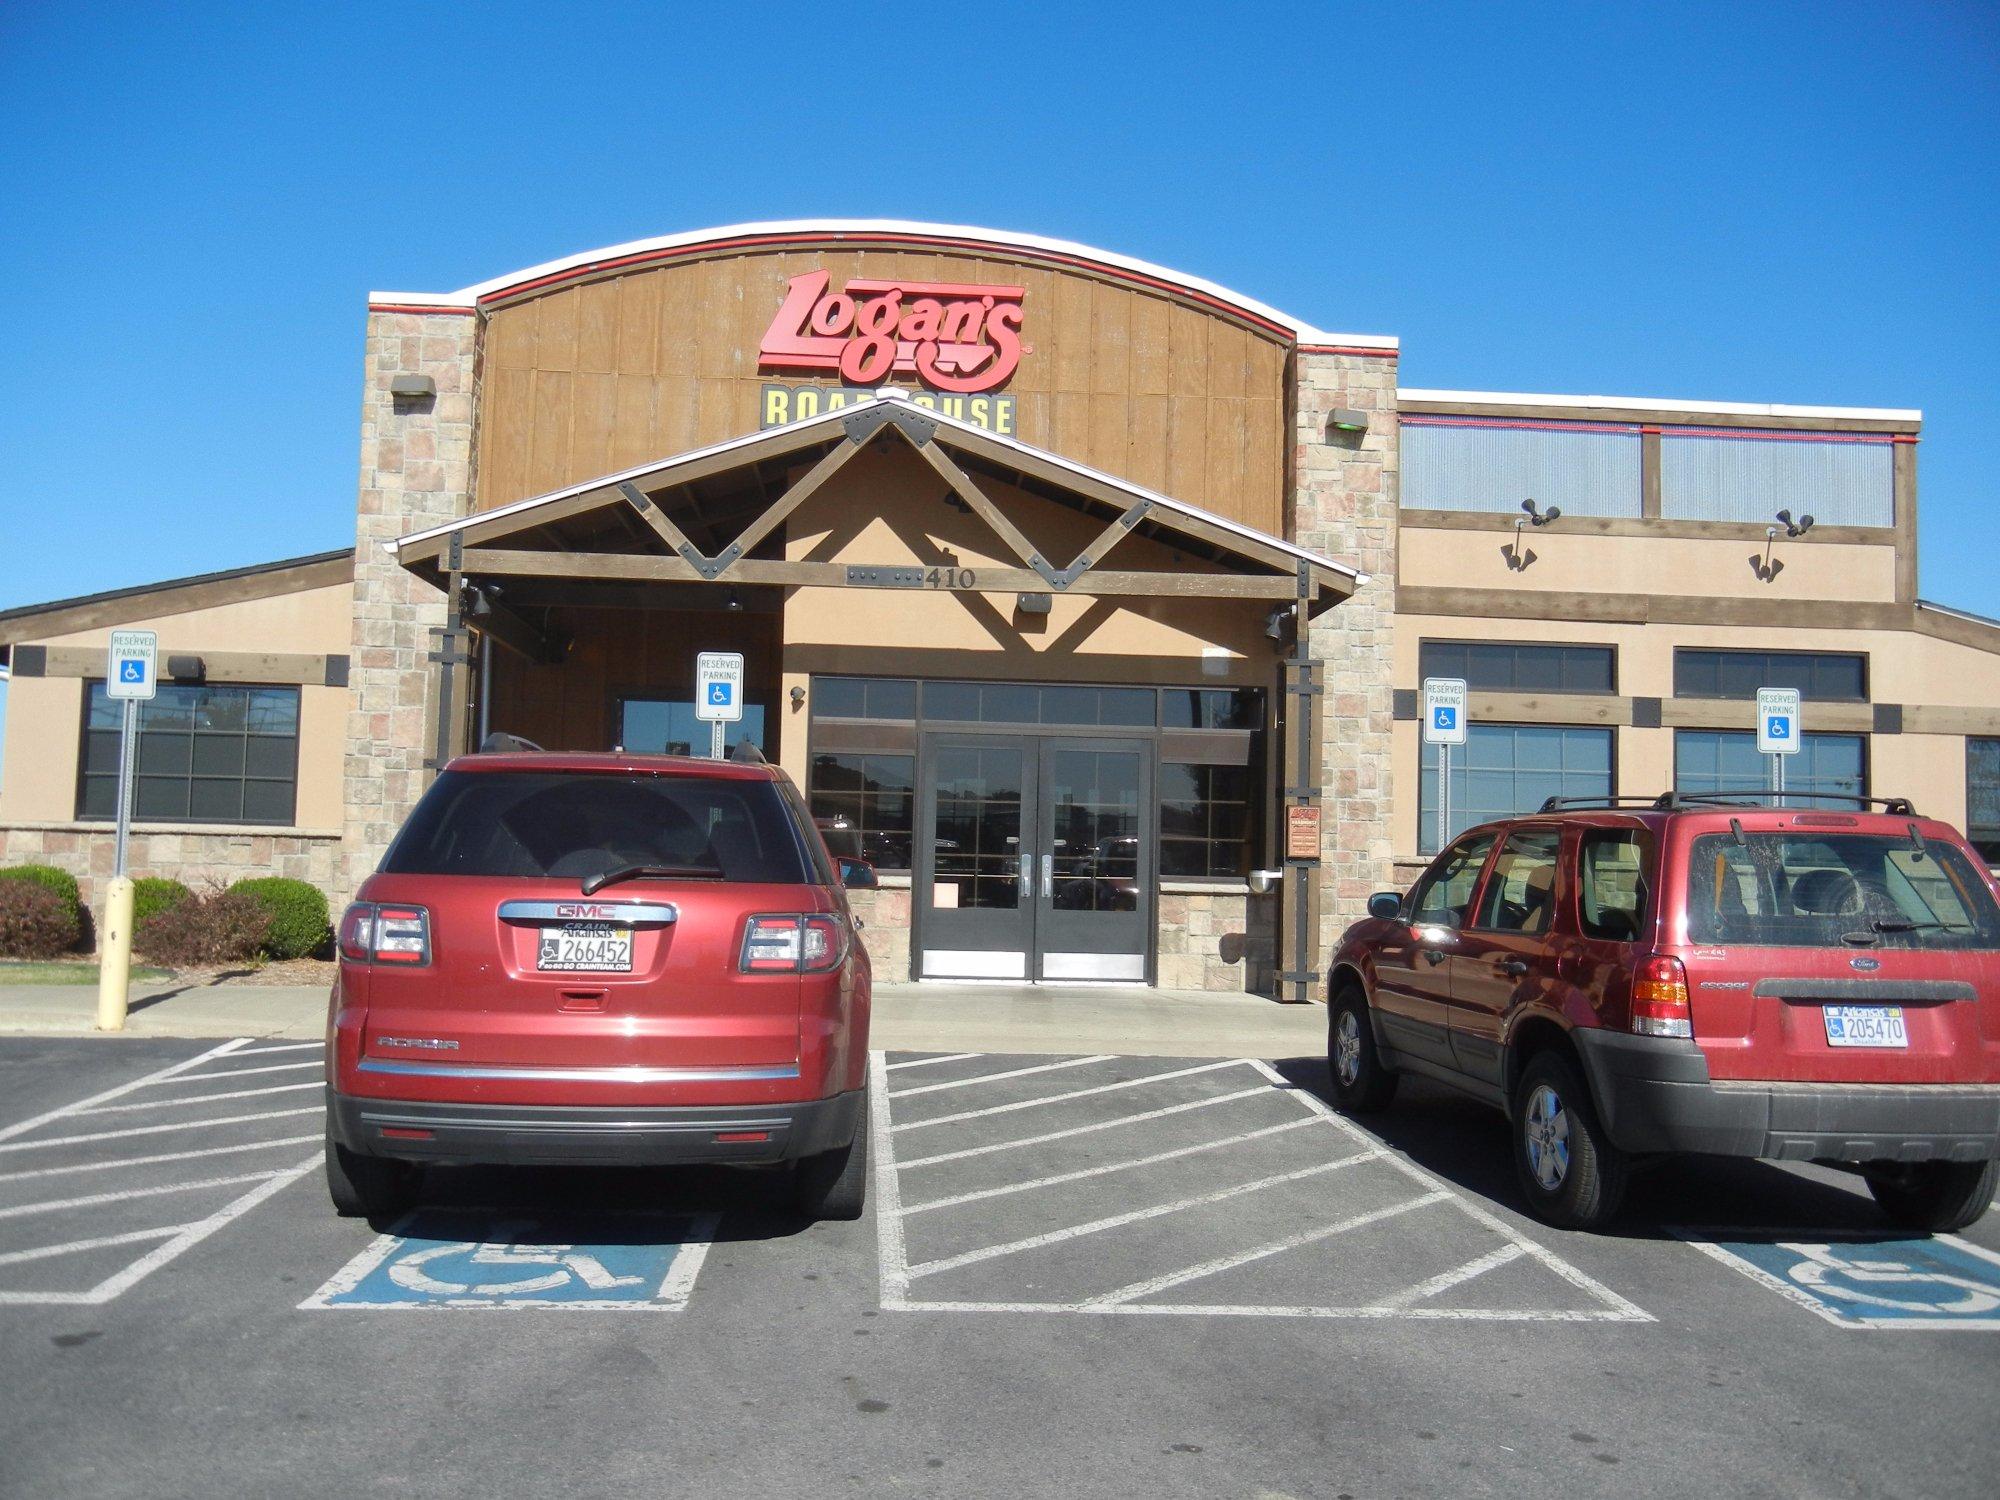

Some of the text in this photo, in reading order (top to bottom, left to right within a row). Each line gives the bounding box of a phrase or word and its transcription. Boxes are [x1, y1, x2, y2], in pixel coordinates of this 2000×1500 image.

[757, 268, 1026, 393] Logan's
[925, 567, 976, 589] 410
[114, 636, 155, 646] RESERVED
[115, 648, 151, 657] PARKING
[701, 659, 740, 669] RESERVED
[703, 671, 737, 680] PARKING
[1427, 684, 1463, 694] RESERVED
[1429, 696, 1461, 704] PARKING
[1760, 694, 1796, 703] RESERVED
[1762, 706, 1794, 714] PARKING
[557, 904, 617, 918] GMC
[564, 922, 610, 930] CRAIN
[564, 940, 628, 963] 266452
[563, 962, 575, 970] GO
[1842, 1007, 1885, 1017] Arkansas
[1847, 1018, 1903, 1039] 205470
